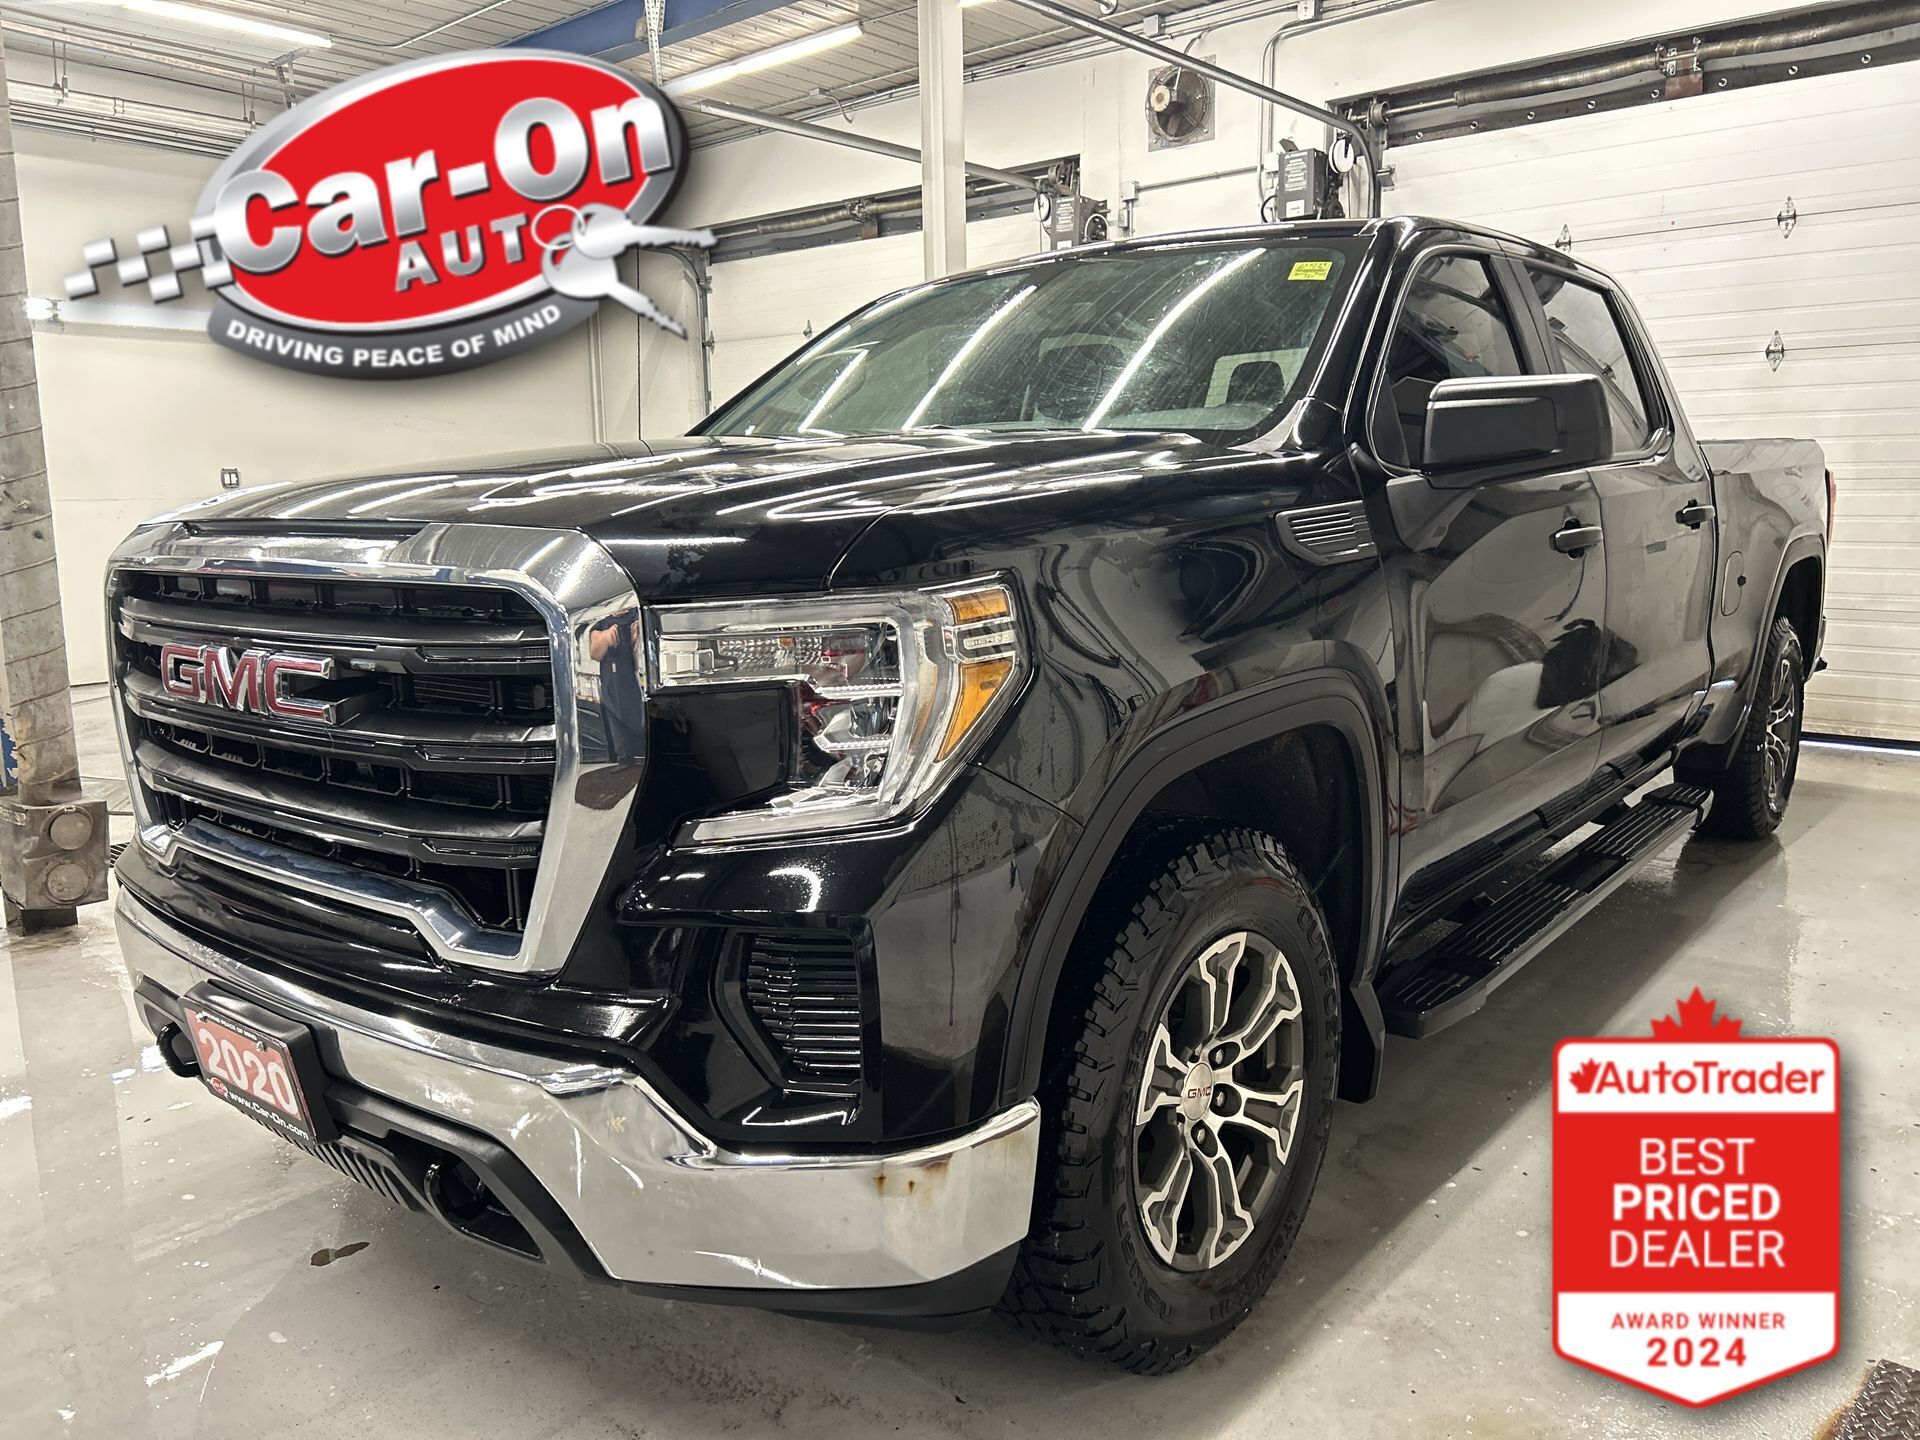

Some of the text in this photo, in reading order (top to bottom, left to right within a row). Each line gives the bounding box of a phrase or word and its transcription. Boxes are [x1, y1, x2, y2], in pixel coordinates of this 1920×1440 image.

[161, 643, 334, 725] GMC
[199, 1028, 299, 1115] 2020
[1188, 1086, 1211, 1099] GMC
[229, 1091, 310, 1141] www.Car-On.com
